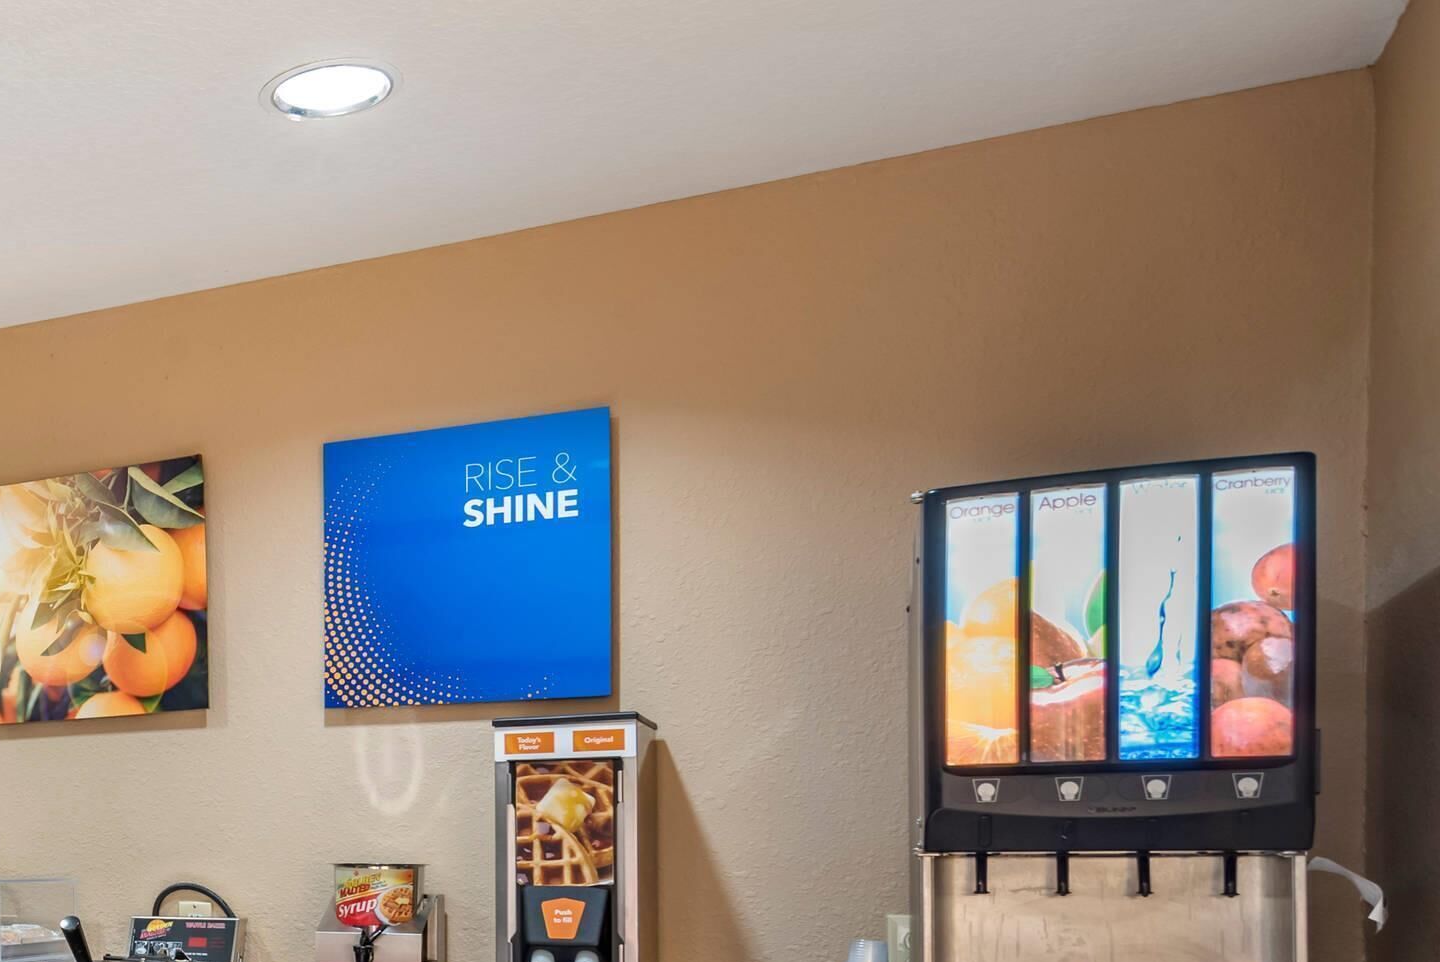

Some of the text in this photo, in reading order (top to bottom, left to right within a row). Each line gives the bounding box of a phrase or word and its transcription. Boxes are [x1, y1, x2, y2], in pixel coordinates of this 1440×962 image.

[465, 451, 577, 493] RISE &
[1215, 476, 1291, 492] Cranberry
[462, 489, 579, 528] SHINE
[949, 503, 1015, 520] Orange
[1038, 493, 1097, 512] Apple
[583, 735, 614, 744] Original
[338, 898, 377, 918] Syrup
